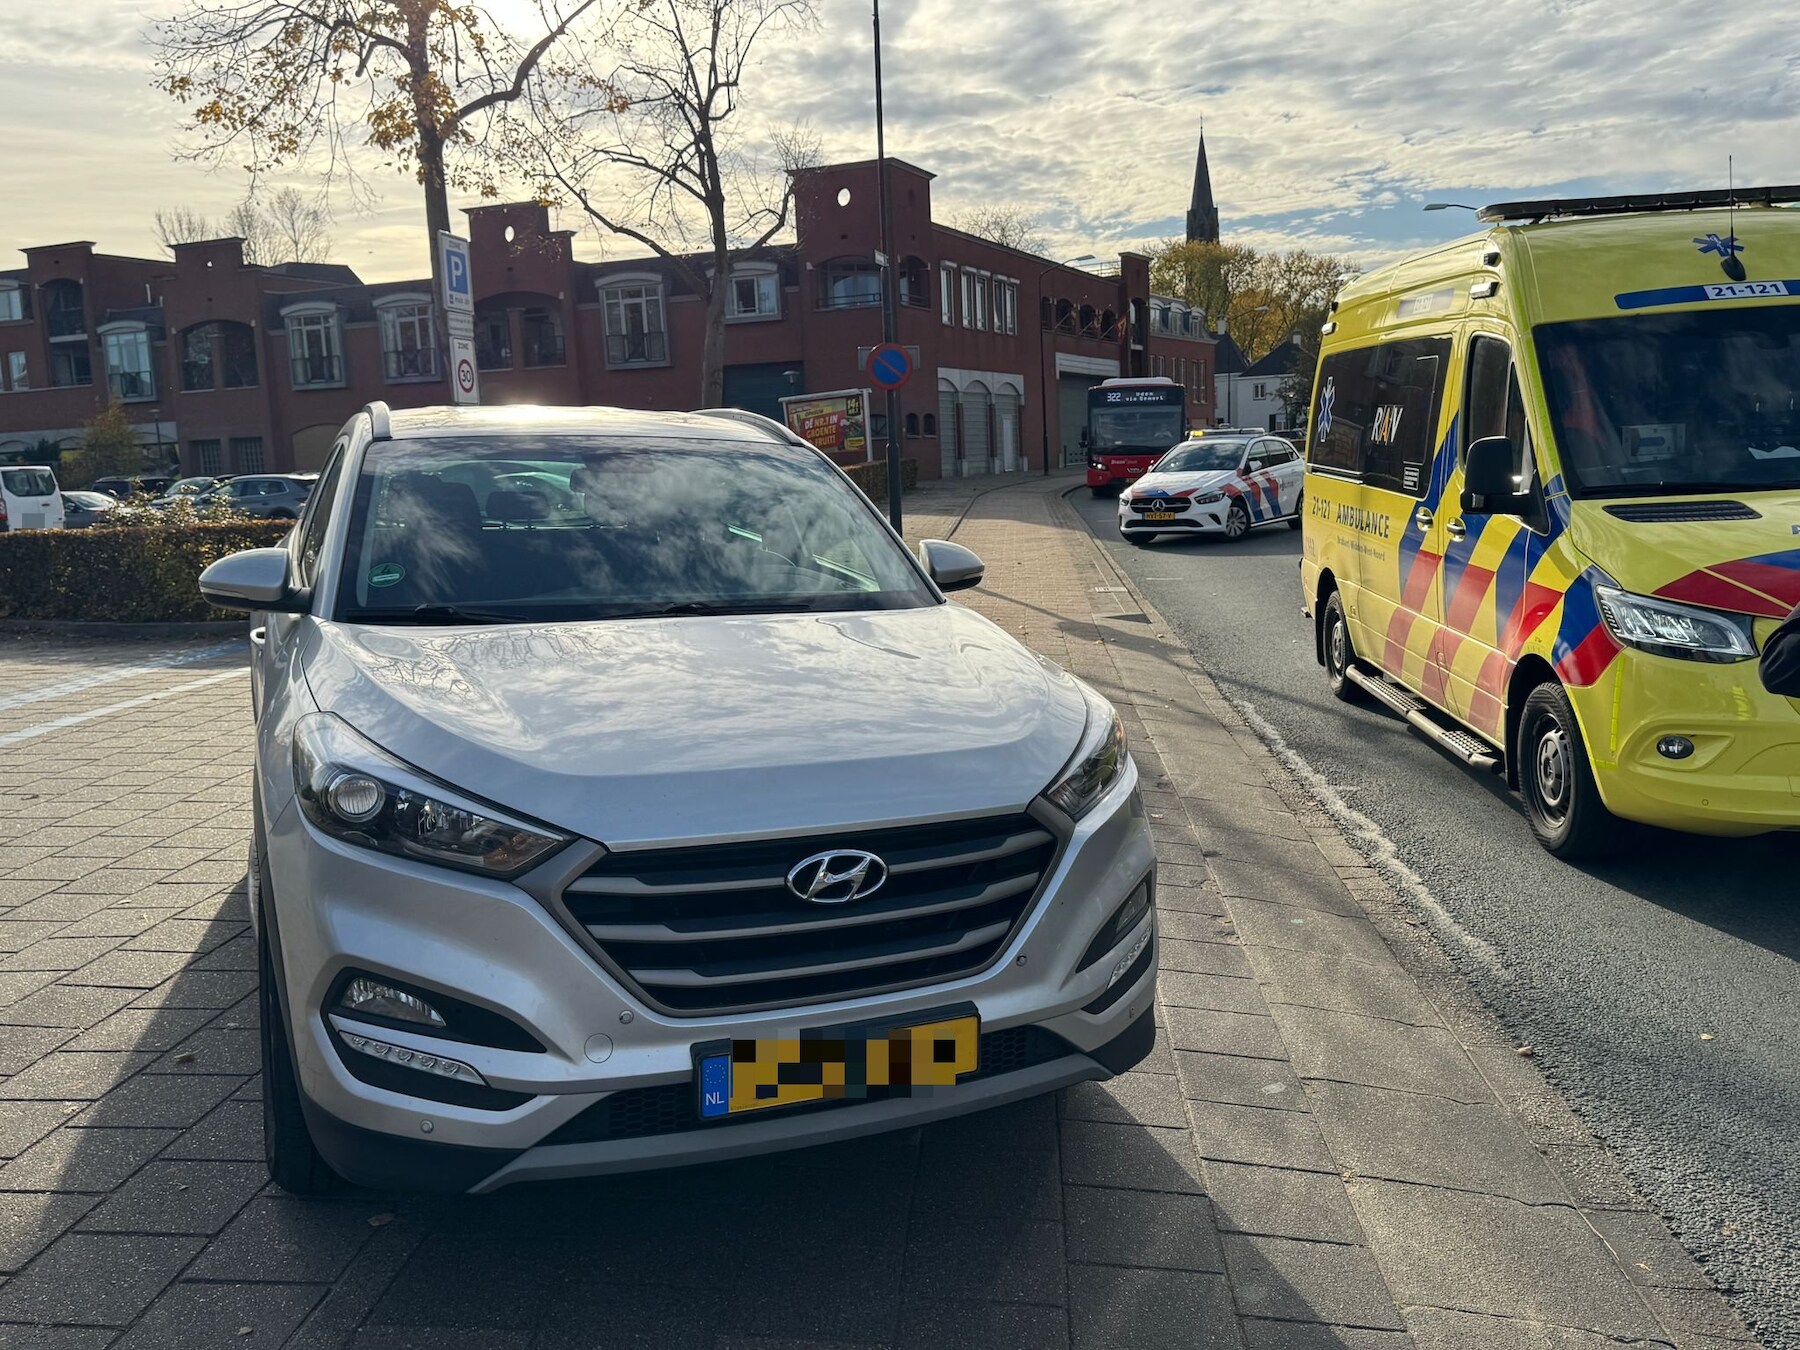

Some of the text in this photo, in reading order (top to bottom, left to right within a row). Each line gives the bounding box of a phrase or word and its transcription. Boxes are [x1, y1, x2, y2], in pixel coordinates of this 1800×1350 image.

[451, 255, 463, 288] P
[1712, 283, 1781, 297] 21-121
[457, 342, 469, 351] ZONE
[461, 369, 472, 383] 30
[1107, 392, 1121, 402] 322
[829, 414, 838, 424] IN
[806, 425, 837, 439] GROENTE
[1312, 496, 1390, 539] 21-121 AMBULANCE
[705, 1091, 725, 1106] NL
